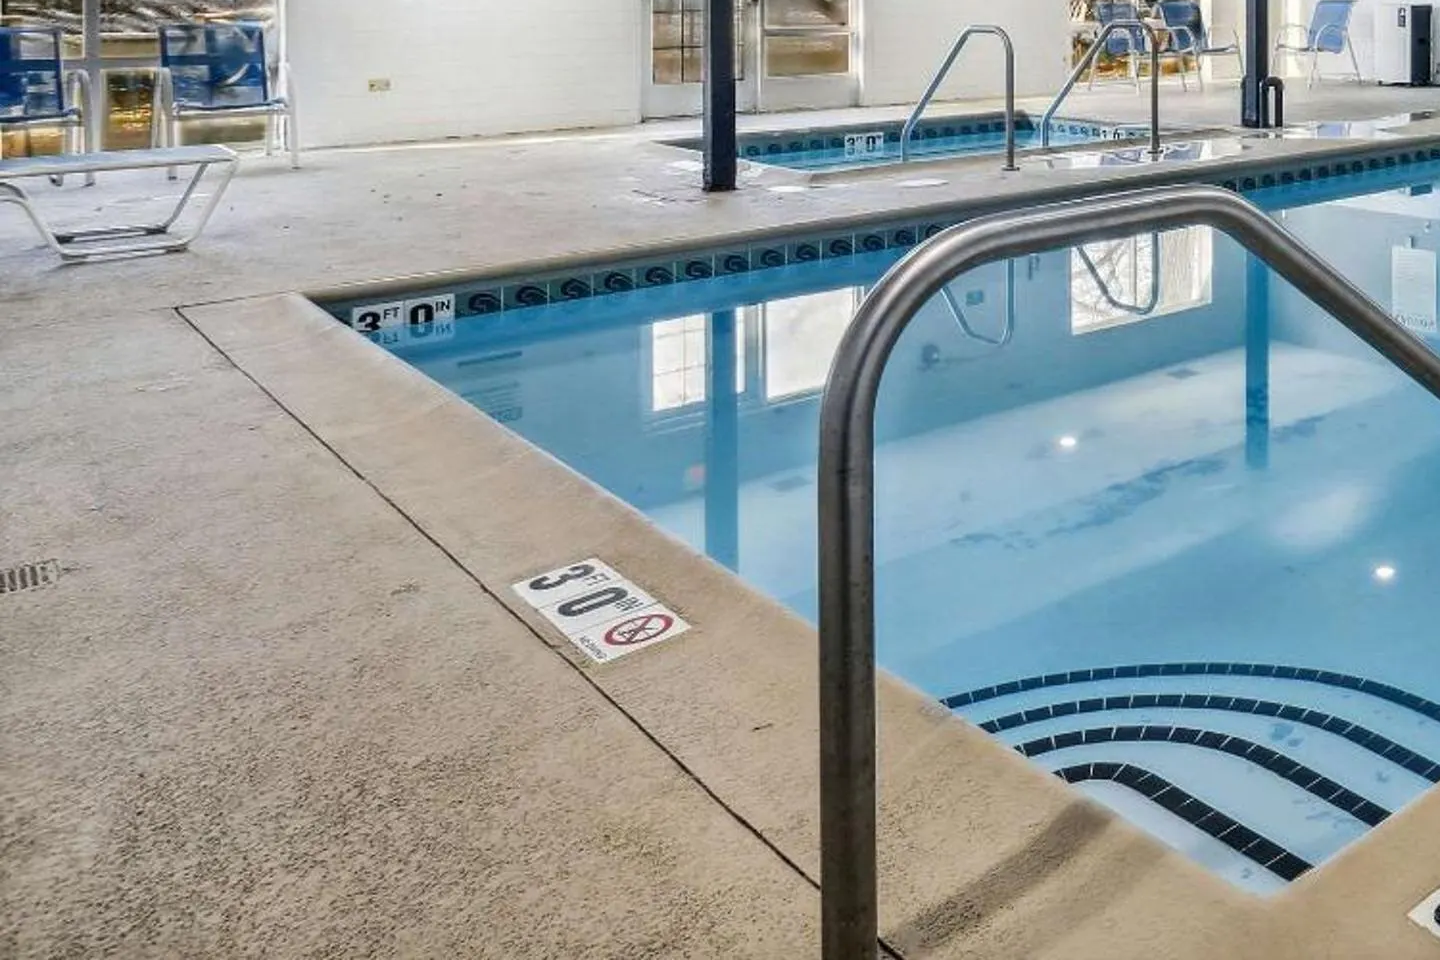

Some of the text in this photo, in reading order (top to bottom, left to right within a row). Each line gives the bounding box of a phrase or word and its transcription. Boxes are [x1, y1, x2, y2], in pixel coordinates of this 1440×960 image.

[357, 312, 381, 332] 3
[383, 306, 400, 320] FT
[435, 300, 451, 313] IN
[529, 564, 595, 591] 3
[557, 587, 629, 617] 0
